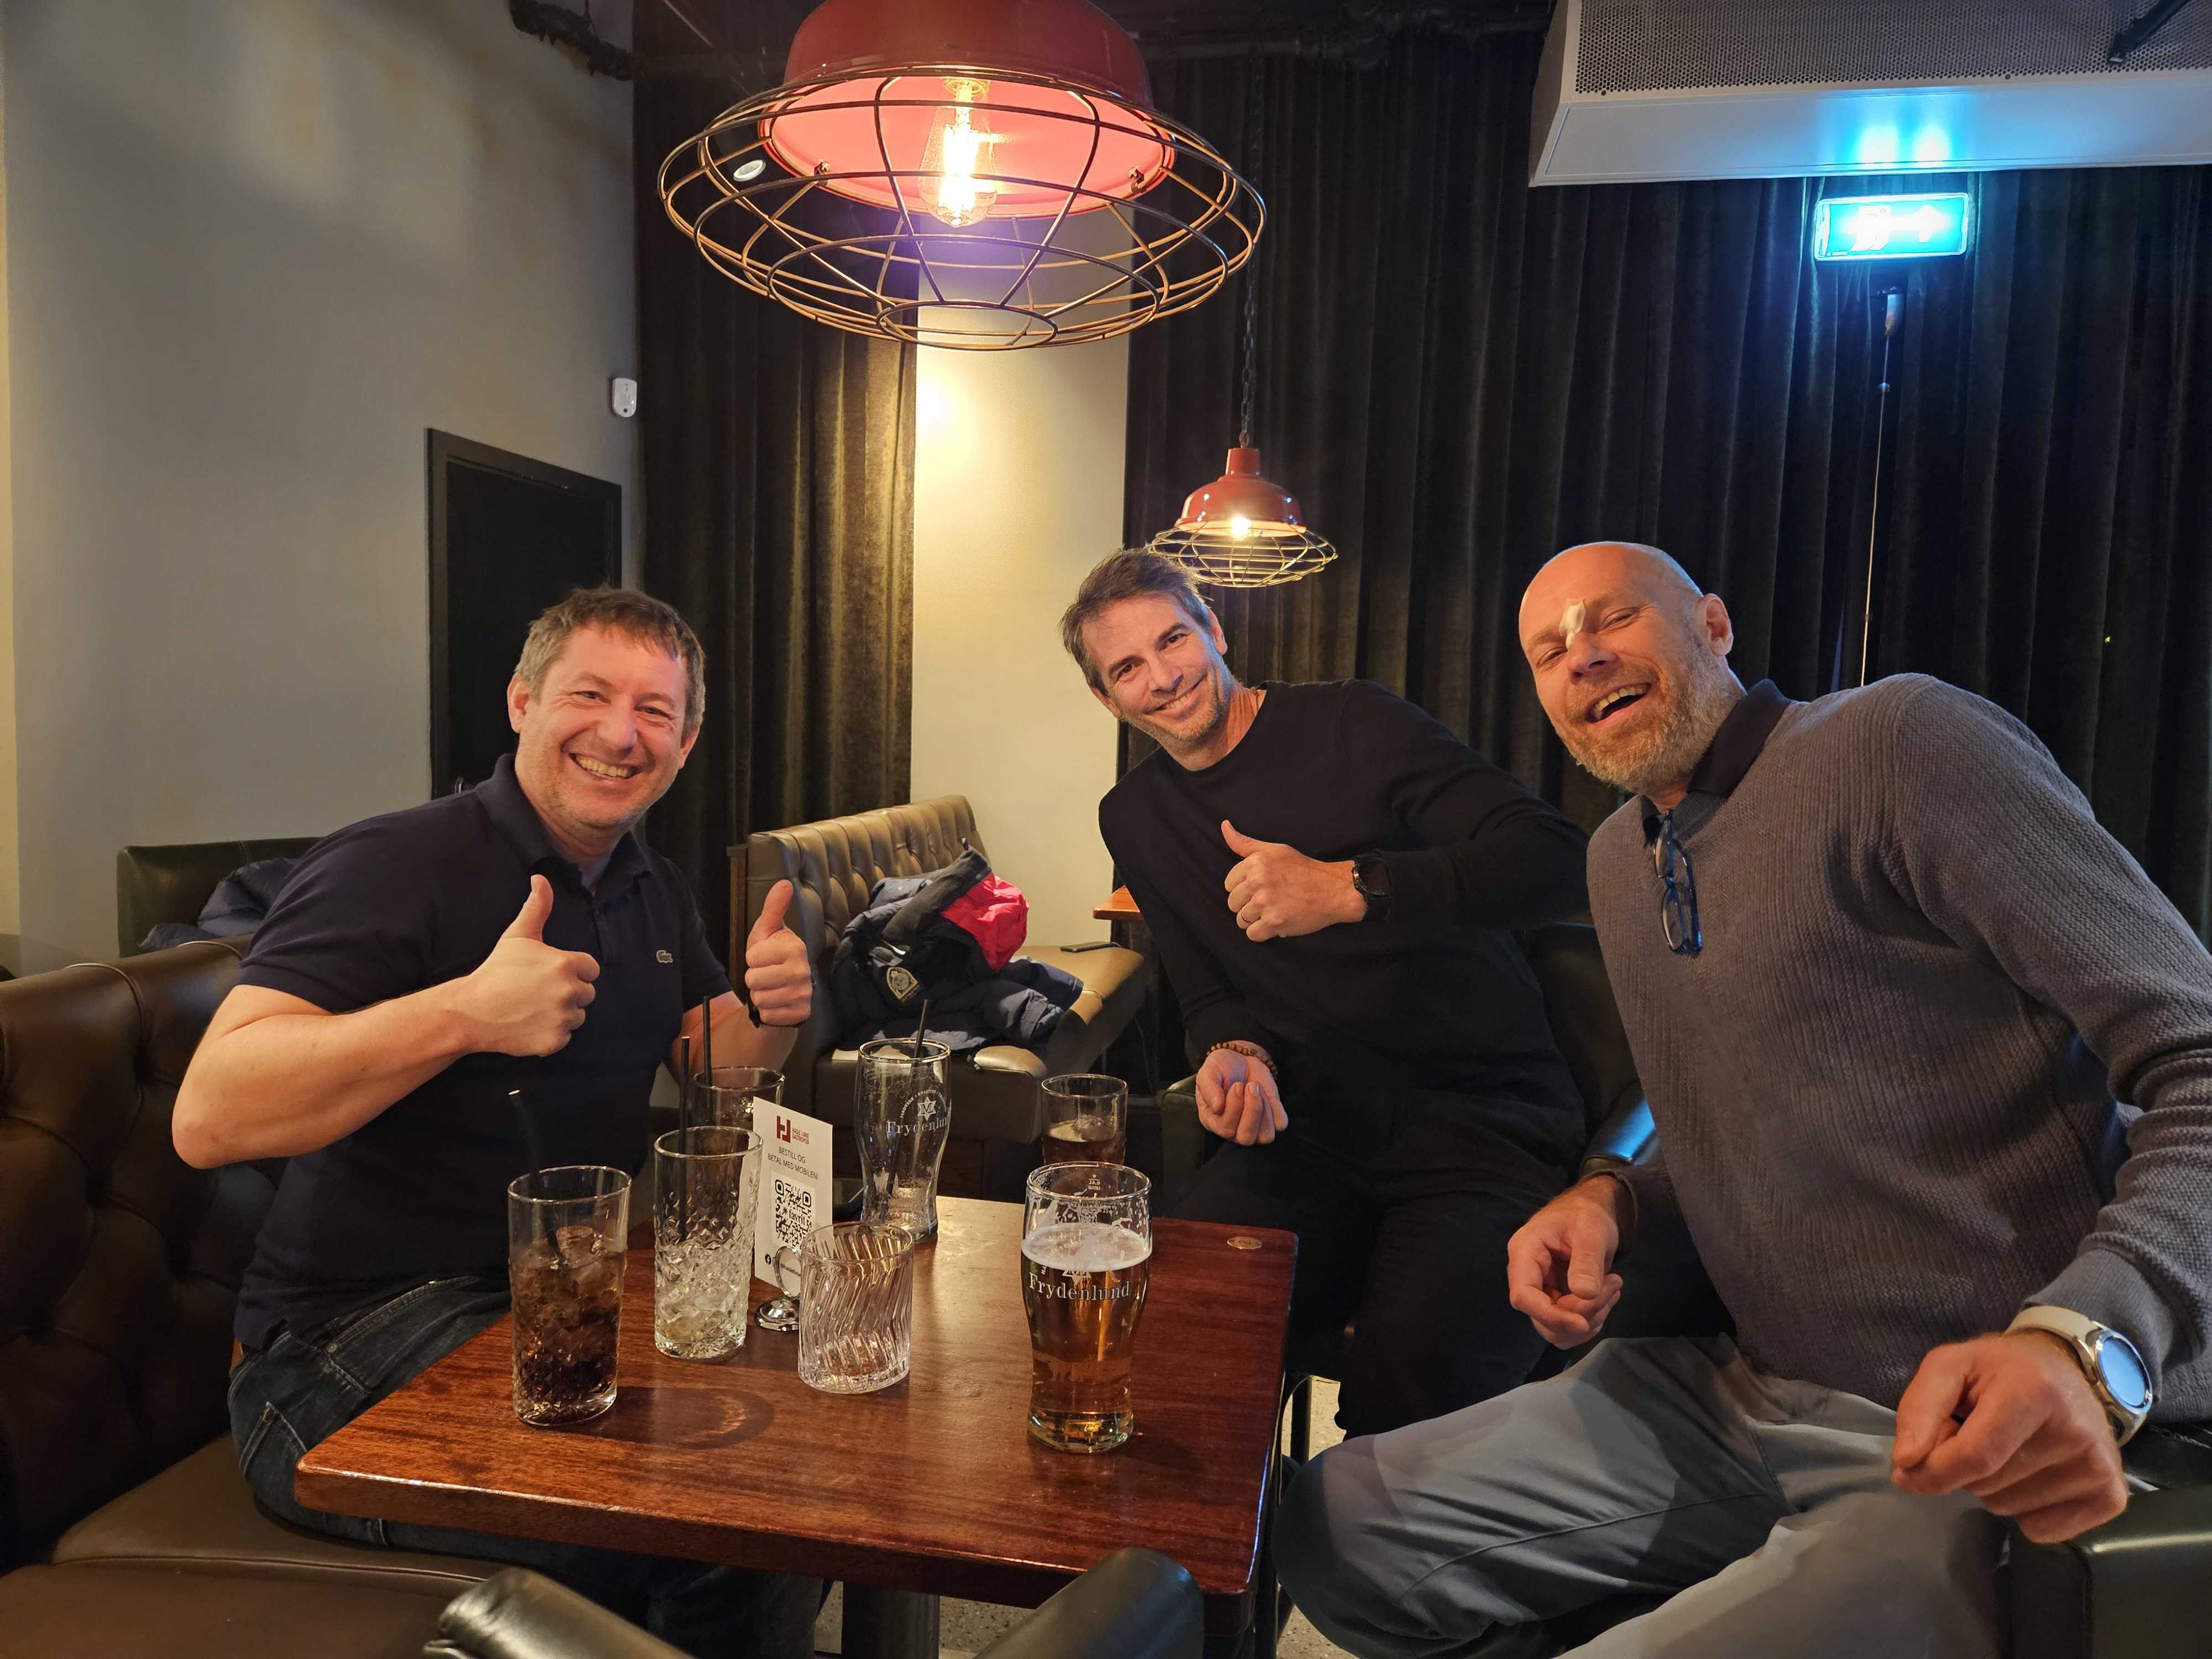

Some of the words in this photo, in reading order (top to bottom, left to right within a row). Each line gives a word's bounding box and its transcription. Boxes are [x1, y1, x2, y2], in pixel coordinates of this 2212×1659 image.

[792, 1133, 809, 1145] GASTROPUB
[779, 1146, 796, 1160] BESTILL
[797, 1154, 806, 1164] OG
[768, 1153, 782, 1165] BETAL
[782, 1160, 794, 1170] MED
[795, 1164, 818, 1181] MOBILEN!
[789, 1209, 806, 1225] favrit
[1029, 1272, 1129, 1301] Frydenlund
